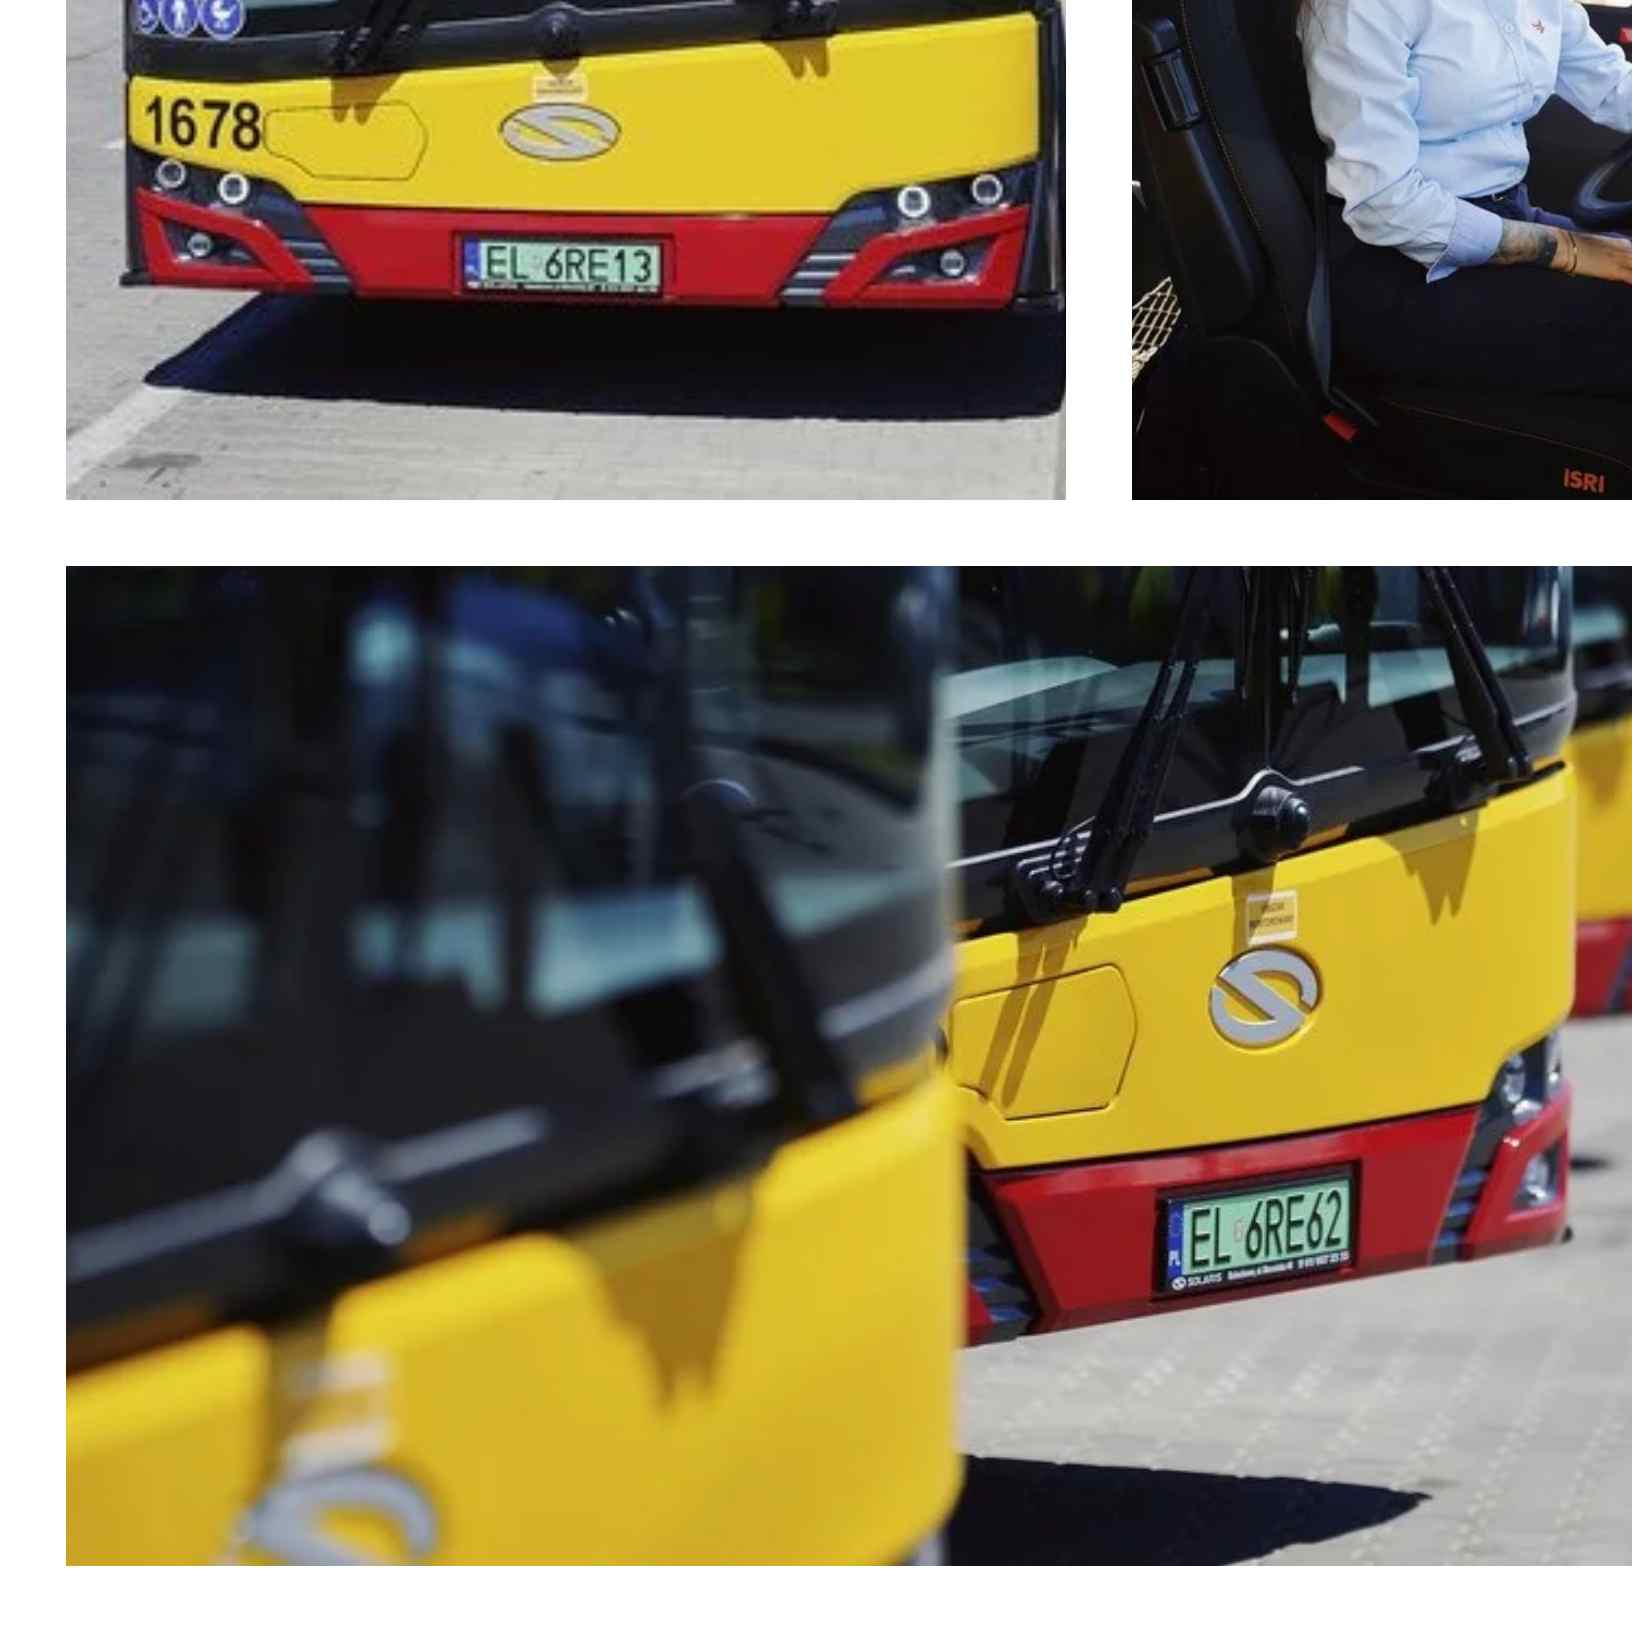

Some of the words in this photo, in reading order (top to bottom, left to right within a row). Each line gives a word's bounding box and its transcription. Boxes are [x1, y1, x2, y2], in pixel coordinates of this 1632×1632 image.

[146, 95, 262, 151] 1678
[486, 245, 530, 280] EL
[544, 247, 652, 283] 6RE13
[1563, 468, 1605, 494] ISRI
[1191, 1207, 1231, 1268] EL
[1244, 1189, 1342, 1259] 6RE62
